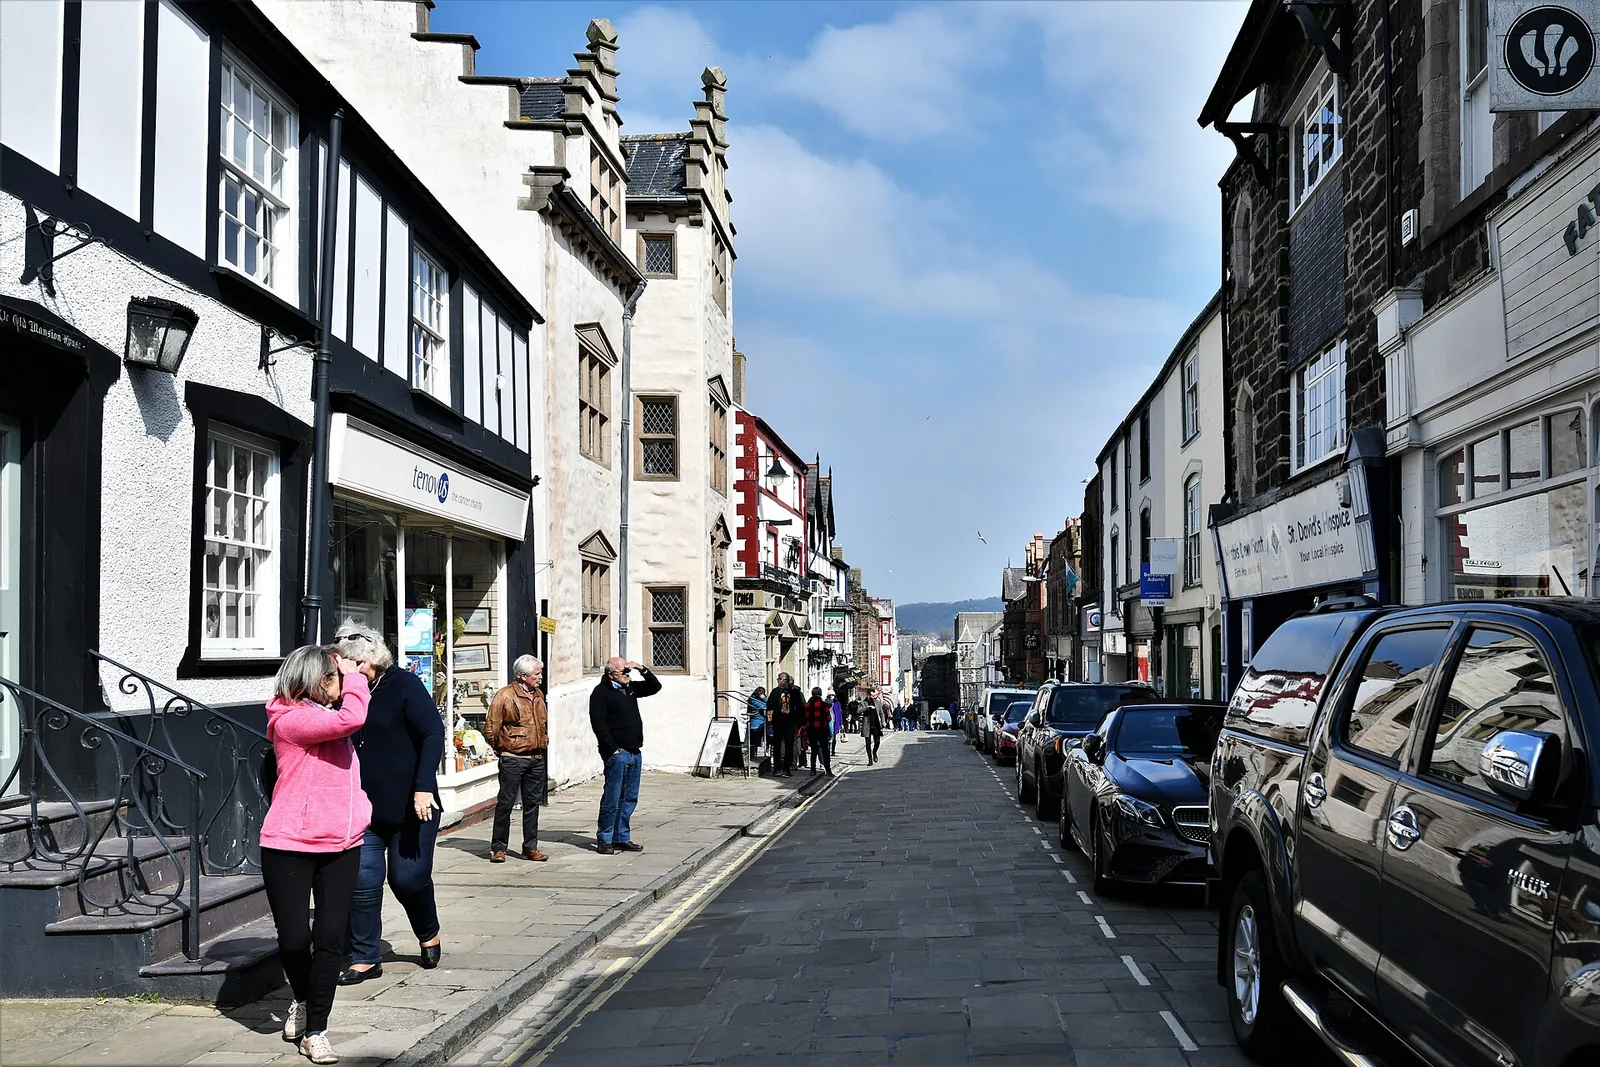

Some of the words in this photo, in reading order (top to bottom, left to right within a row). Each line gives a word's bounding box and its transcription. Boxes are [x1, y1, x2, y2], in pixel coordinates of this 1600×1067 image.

[1563, 182, 1600, 256] FAT
[28, 320, 61, 342] Mansion
[1297, 515, 1322, 541] David's
[1321, 507, 1350, 536] Hospice
[1299, 550, 1311, 562] Your
[1311, 545, 1324, 559] Local
[1324, 542, 1344, 557] Hospice
[1507, 868, 1550, 899] HILUX
